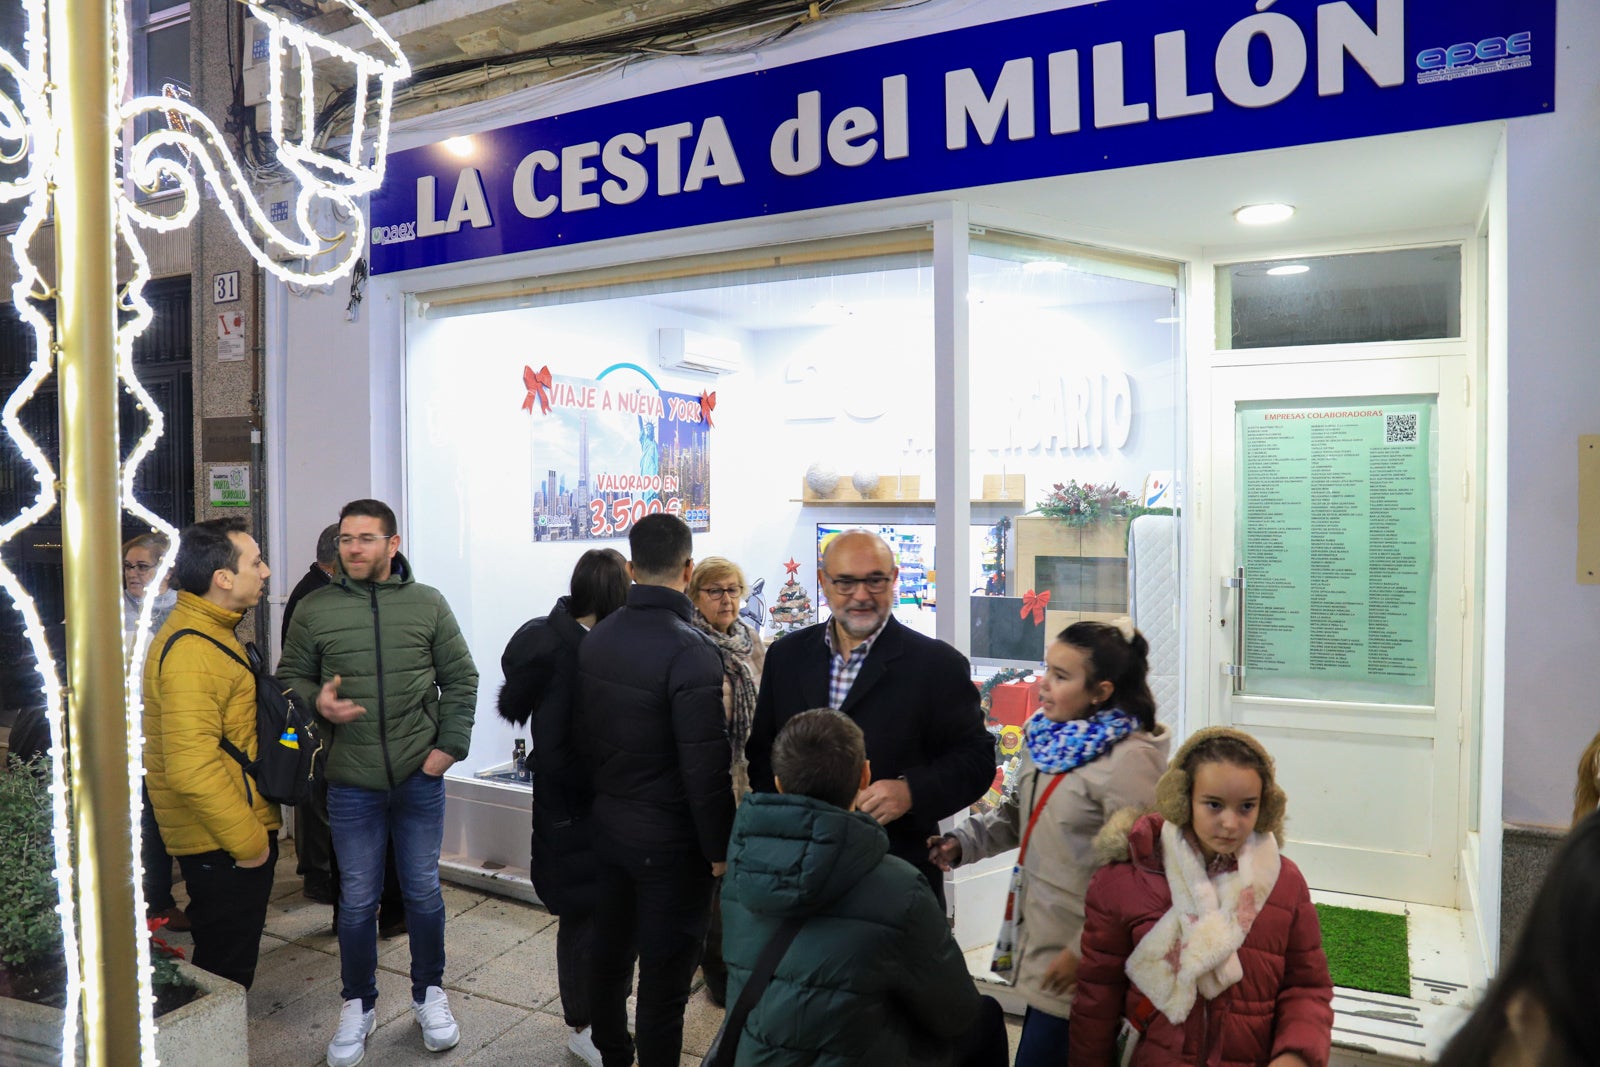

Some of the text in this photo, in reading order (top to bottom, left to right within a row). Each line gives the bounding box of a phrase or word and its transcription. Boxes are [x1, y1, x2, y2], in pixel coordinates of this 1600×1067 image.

[1416, 31, 1531, 69] apac
[416, 0, 1406, 238] LA CESTA del MILLÓN
[217, 275, 234, 300] 31
[549, 383, 702, 423] VIAJE A NUEVA YORK
[1264, 413, 1305, 421] EMPRESAS
[597, 473, 678, 493] VALORADO EN
